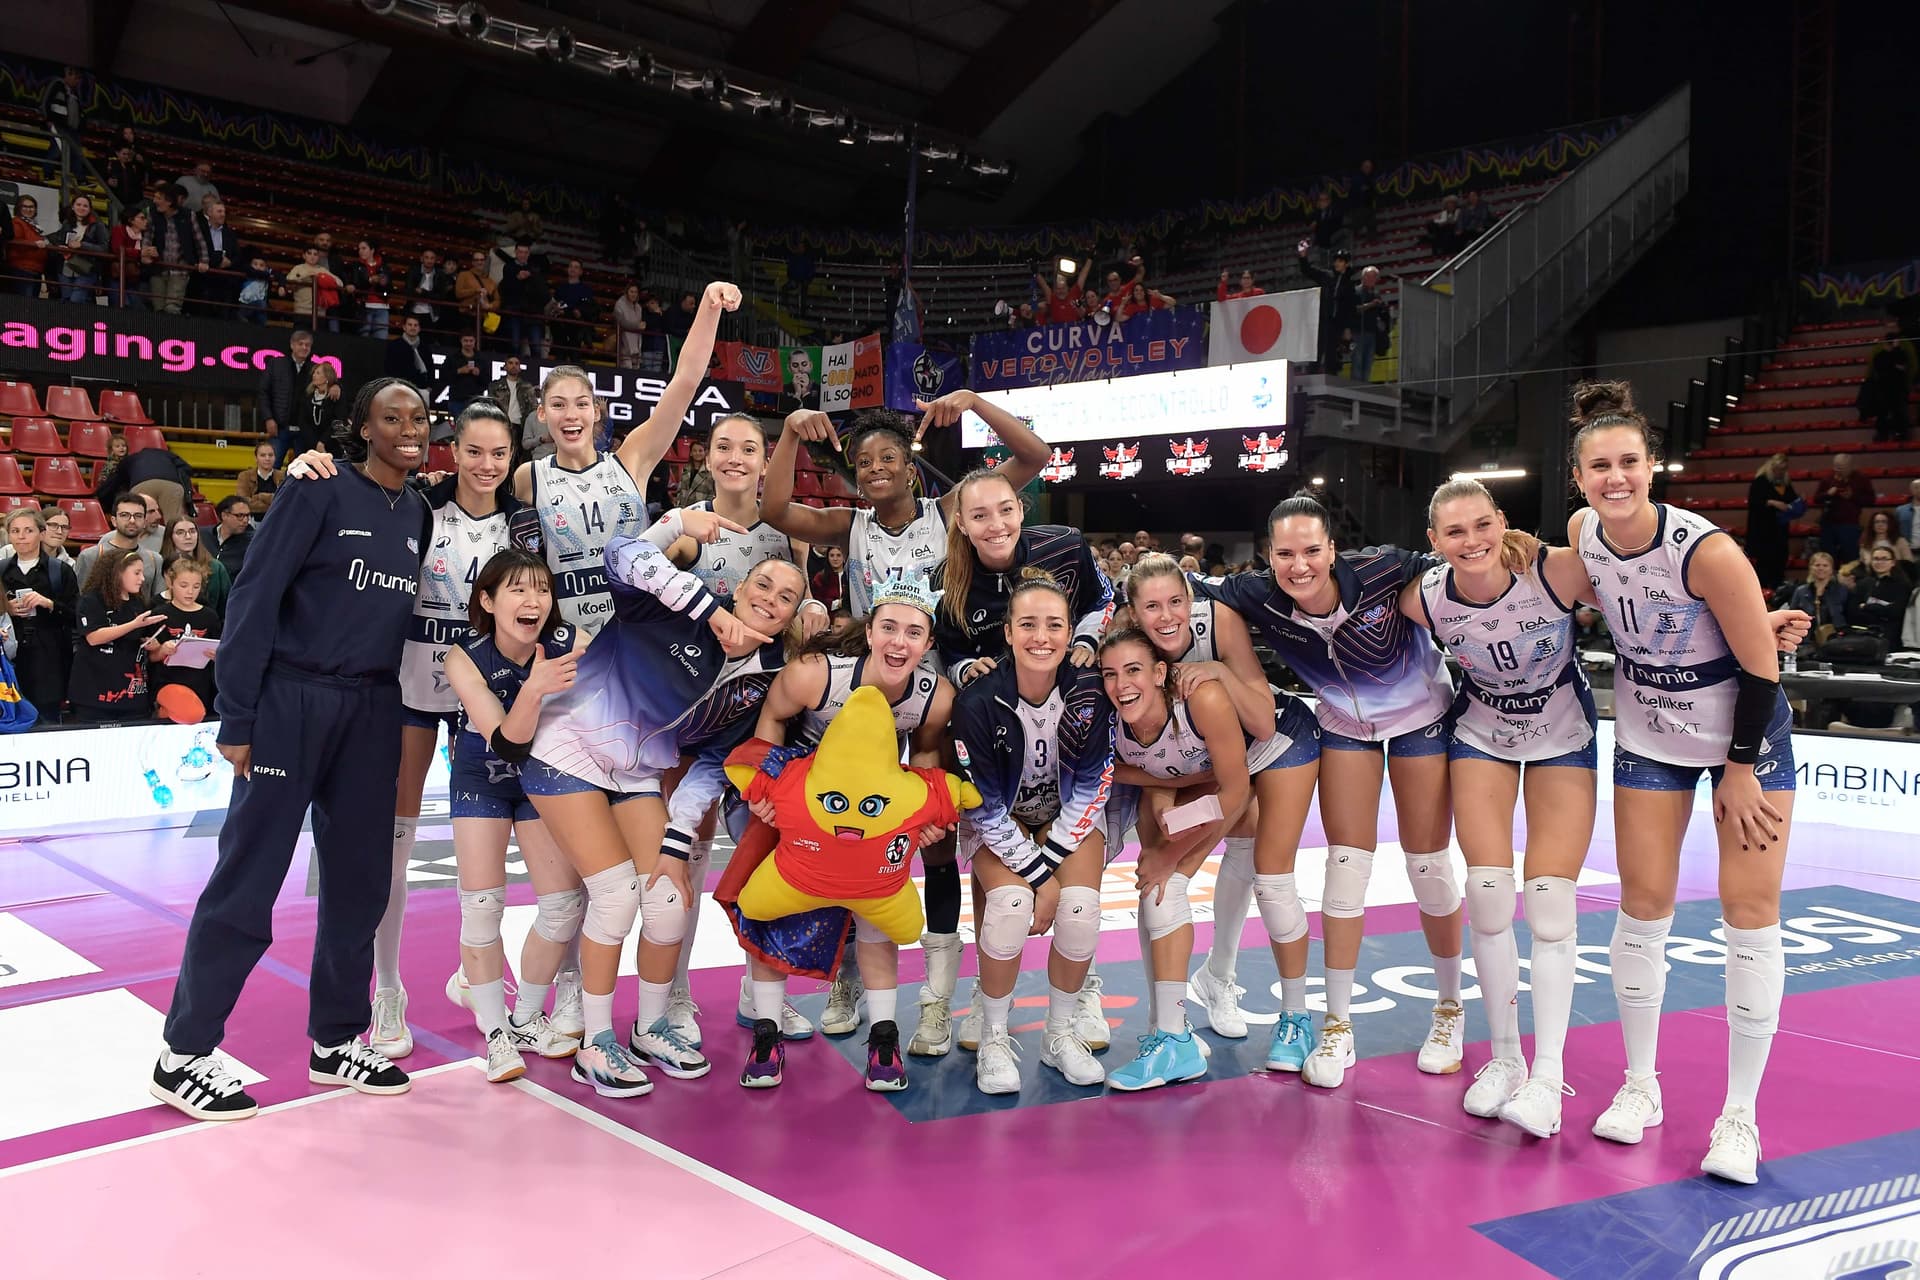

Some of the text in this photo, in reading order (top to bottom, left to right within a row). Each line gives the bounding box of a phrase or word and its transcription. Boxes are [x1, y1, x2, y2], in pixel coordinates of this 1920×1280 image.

[1026, 325, 1124, 353] CURVA
[828, 353, 847, 366] HAI
[982, 337, 1189, 379] VEROVOLLEY
[823, 391, 831, 402] IL
[834, 384, 874, 401] SOGNO
[579, 500, 605, 535] 14
[491, 543, 506, 554] Te
[1583, 550, 1610, 563] mauden
[891, 583, 920, 595] Buon
[577, 599, 614, 617] Koell
[1617, 595, 1640, 634] 11
[1440, 613, 1471, 624] mauden
[1486, 640, 1519, 672] 19
[677, 654, 700, 677] numia
[1637, 667, 1699, 684] numia
[1518, 722, 1551, 742] TXT
[1667, 722, 1702, 735] TXT
[1034, 738, 1048, 768] 3
[253, 765, 287, 777] KIPSTA
[1817, 791, 1897, 807] GIOIELLI
